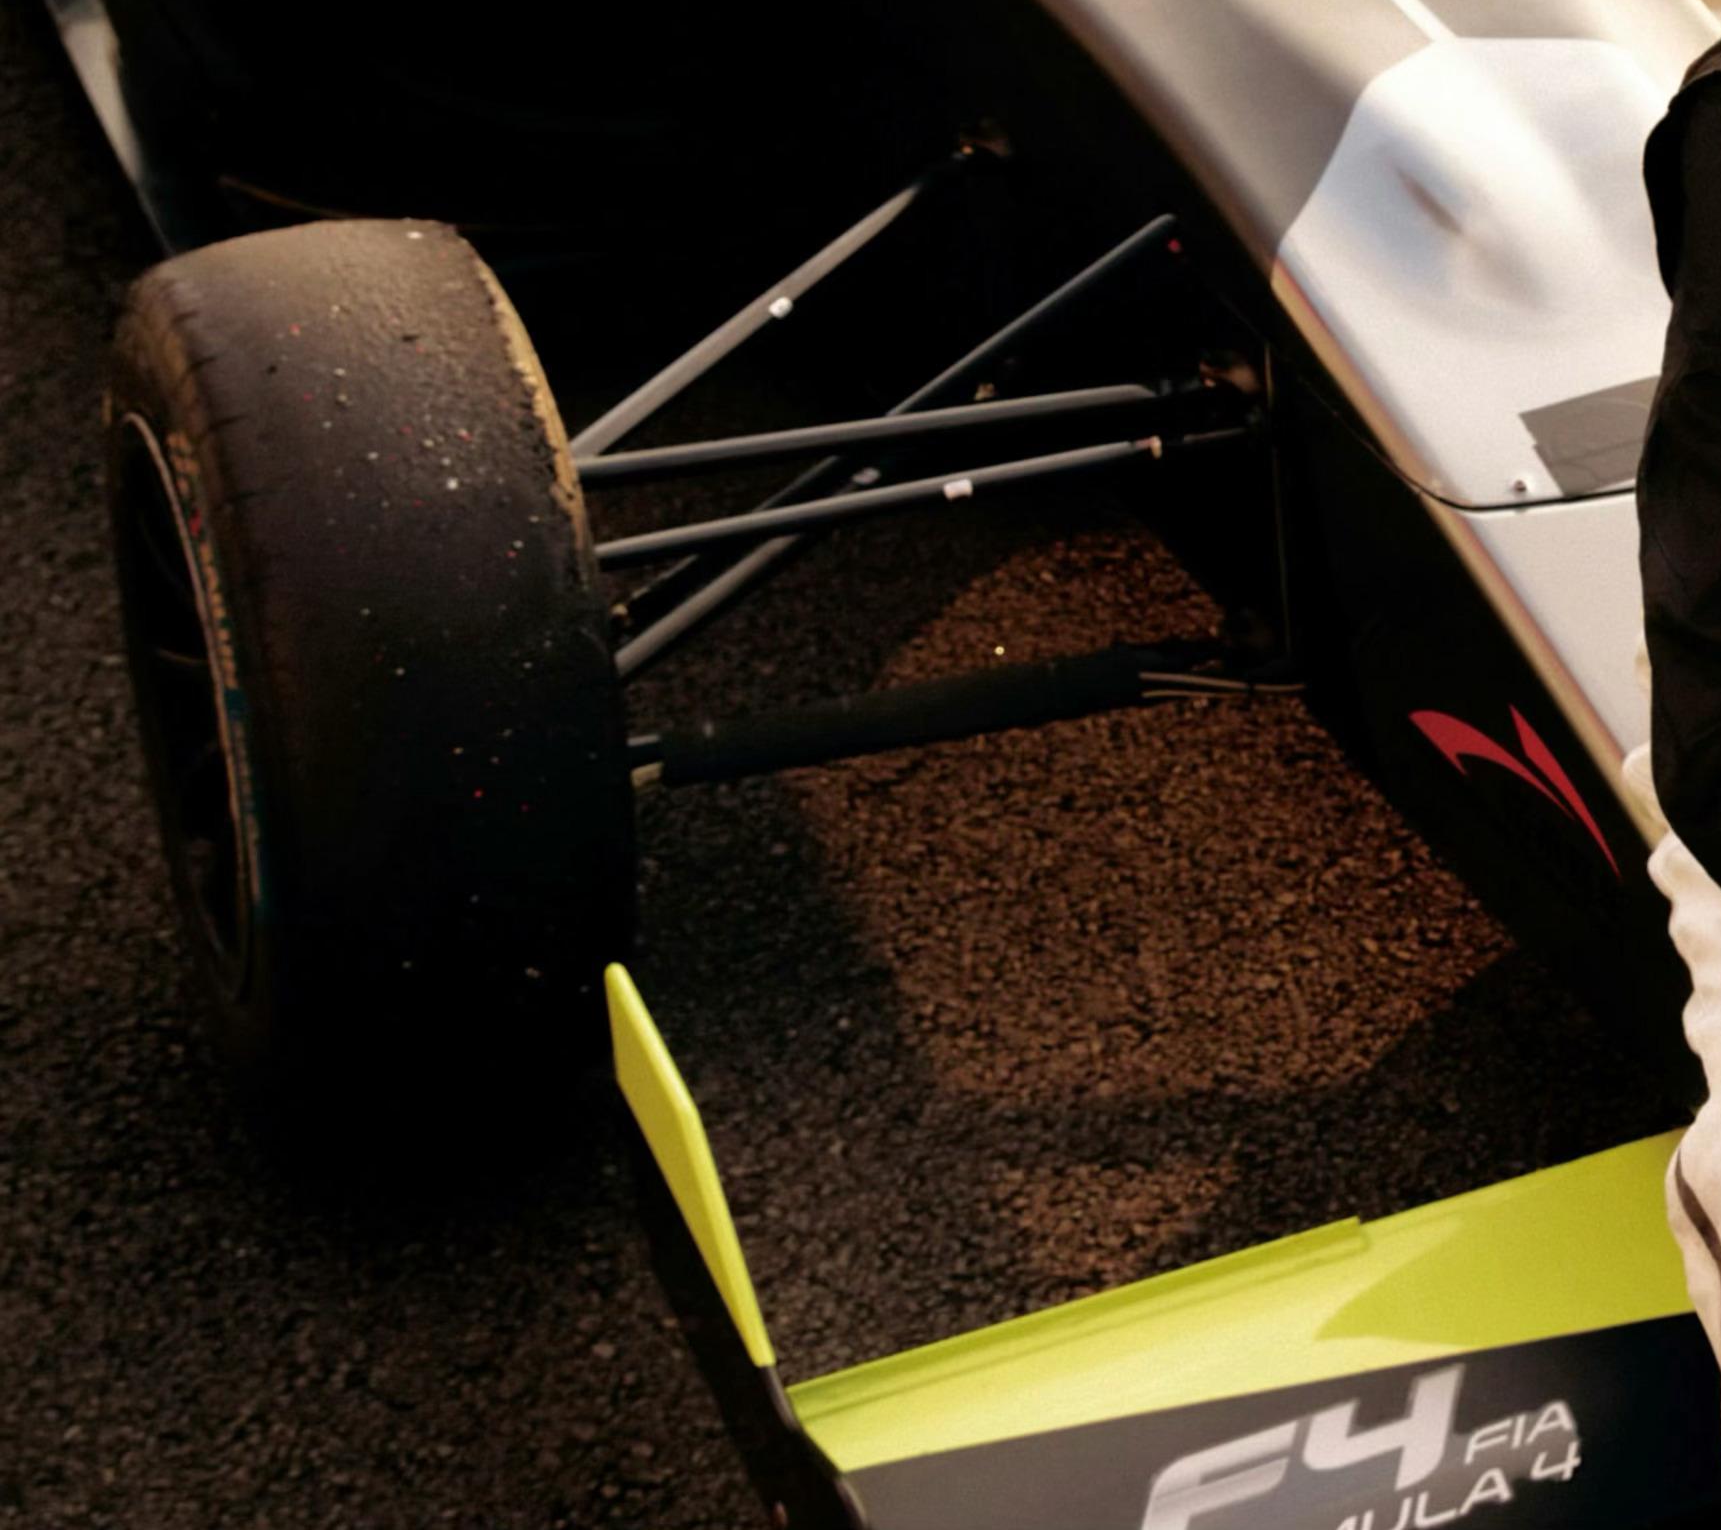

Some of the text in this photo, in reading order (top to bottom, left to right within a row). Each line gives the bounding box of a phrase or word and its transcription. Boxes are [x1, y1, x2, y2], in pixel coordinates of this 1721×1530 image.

[1140, 1362, 1574, 1530] F4 FIA
[1530, 1440, 1582, 1481] 4
